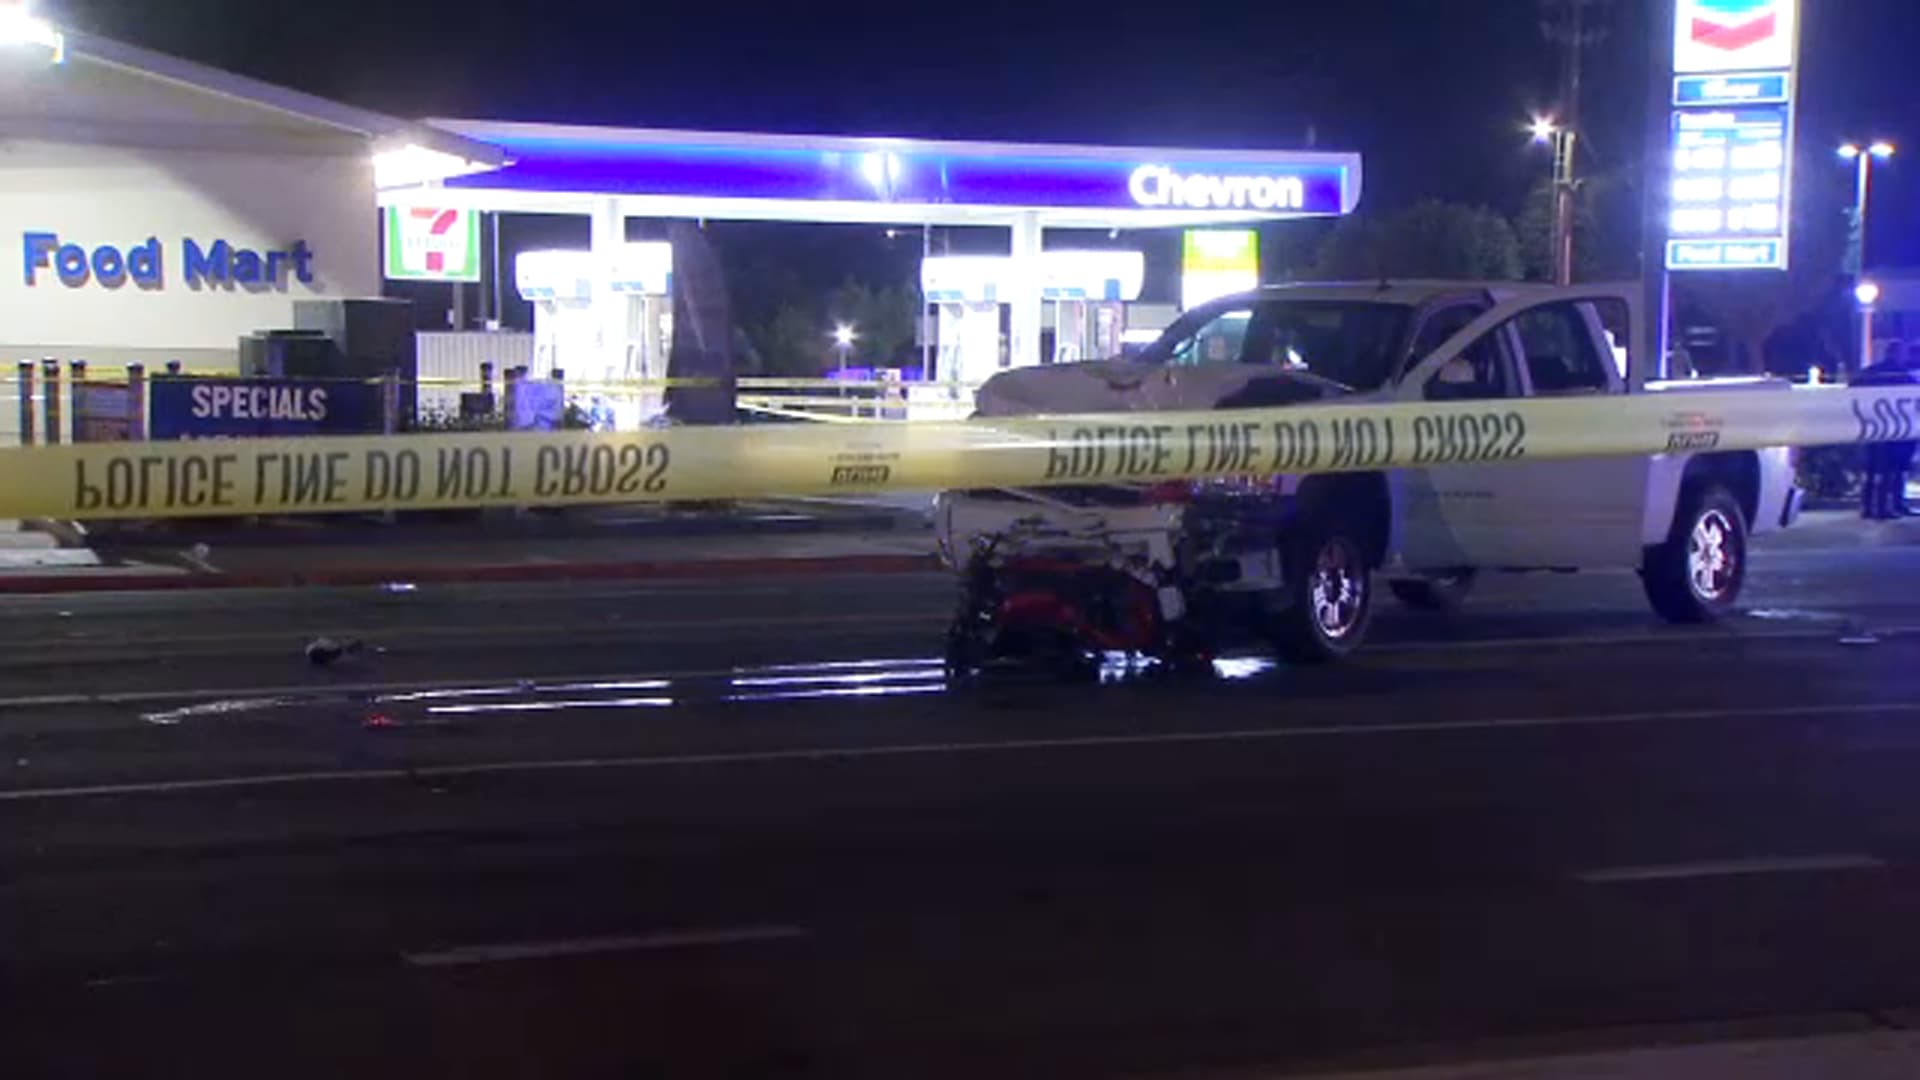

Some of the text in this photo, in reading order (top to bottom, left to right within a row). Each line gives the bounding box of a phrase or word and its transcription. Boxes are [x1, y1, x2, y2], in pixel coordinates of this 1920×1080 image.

[1128, 164, 1303, 209] Chevron
[22, 231, 316, 292] Food Mart
[191, 385, 328, 421] SPECIALS
